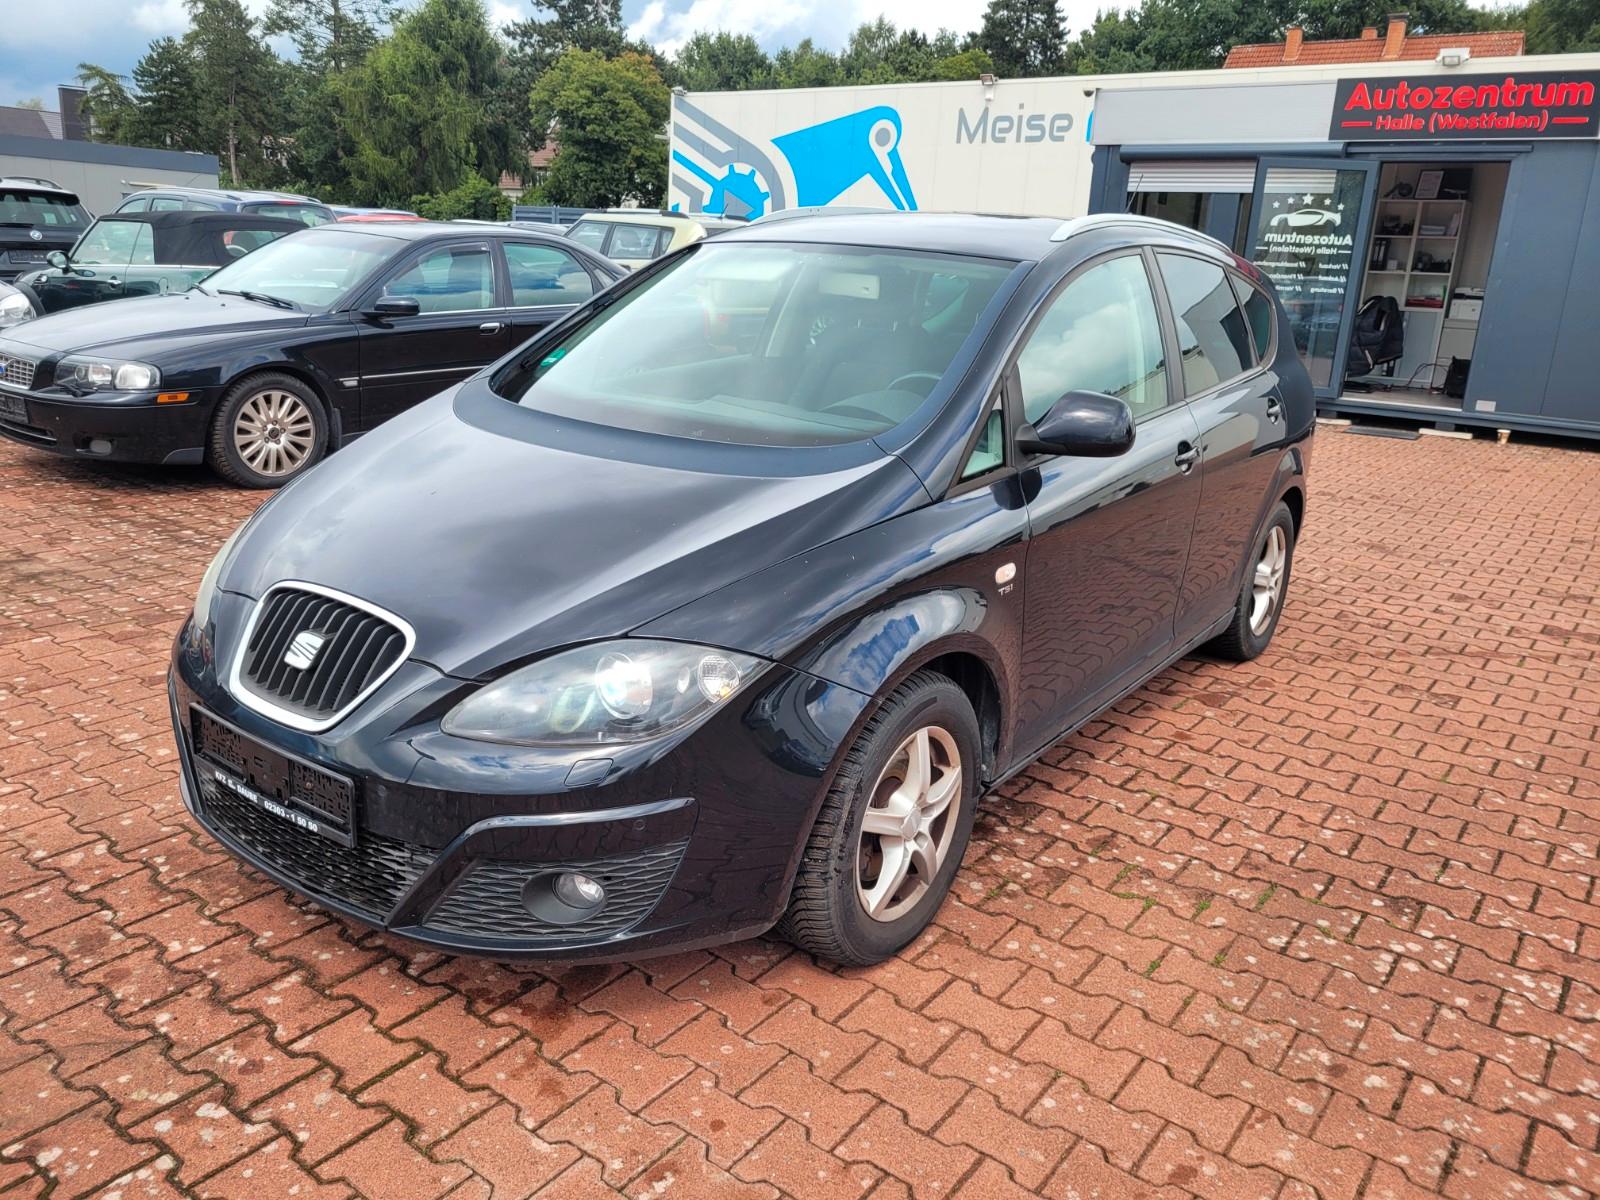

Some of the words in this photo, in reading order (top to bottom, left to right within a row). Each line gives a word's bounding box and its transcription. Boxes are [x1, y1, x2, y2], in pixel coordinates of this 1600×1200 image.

[1344, 77, 1595, 111] Autozentrum
[956, 103, 1074, 144] Meise
[1375, 113, 1425, 131] Halle
[1428, 110, 1549, 133] (Westfalen)
[998, 583, 1013, 596] TSI
[215, 770, 227, 784] KFZ
[264, 800, 286, 817] 02303
